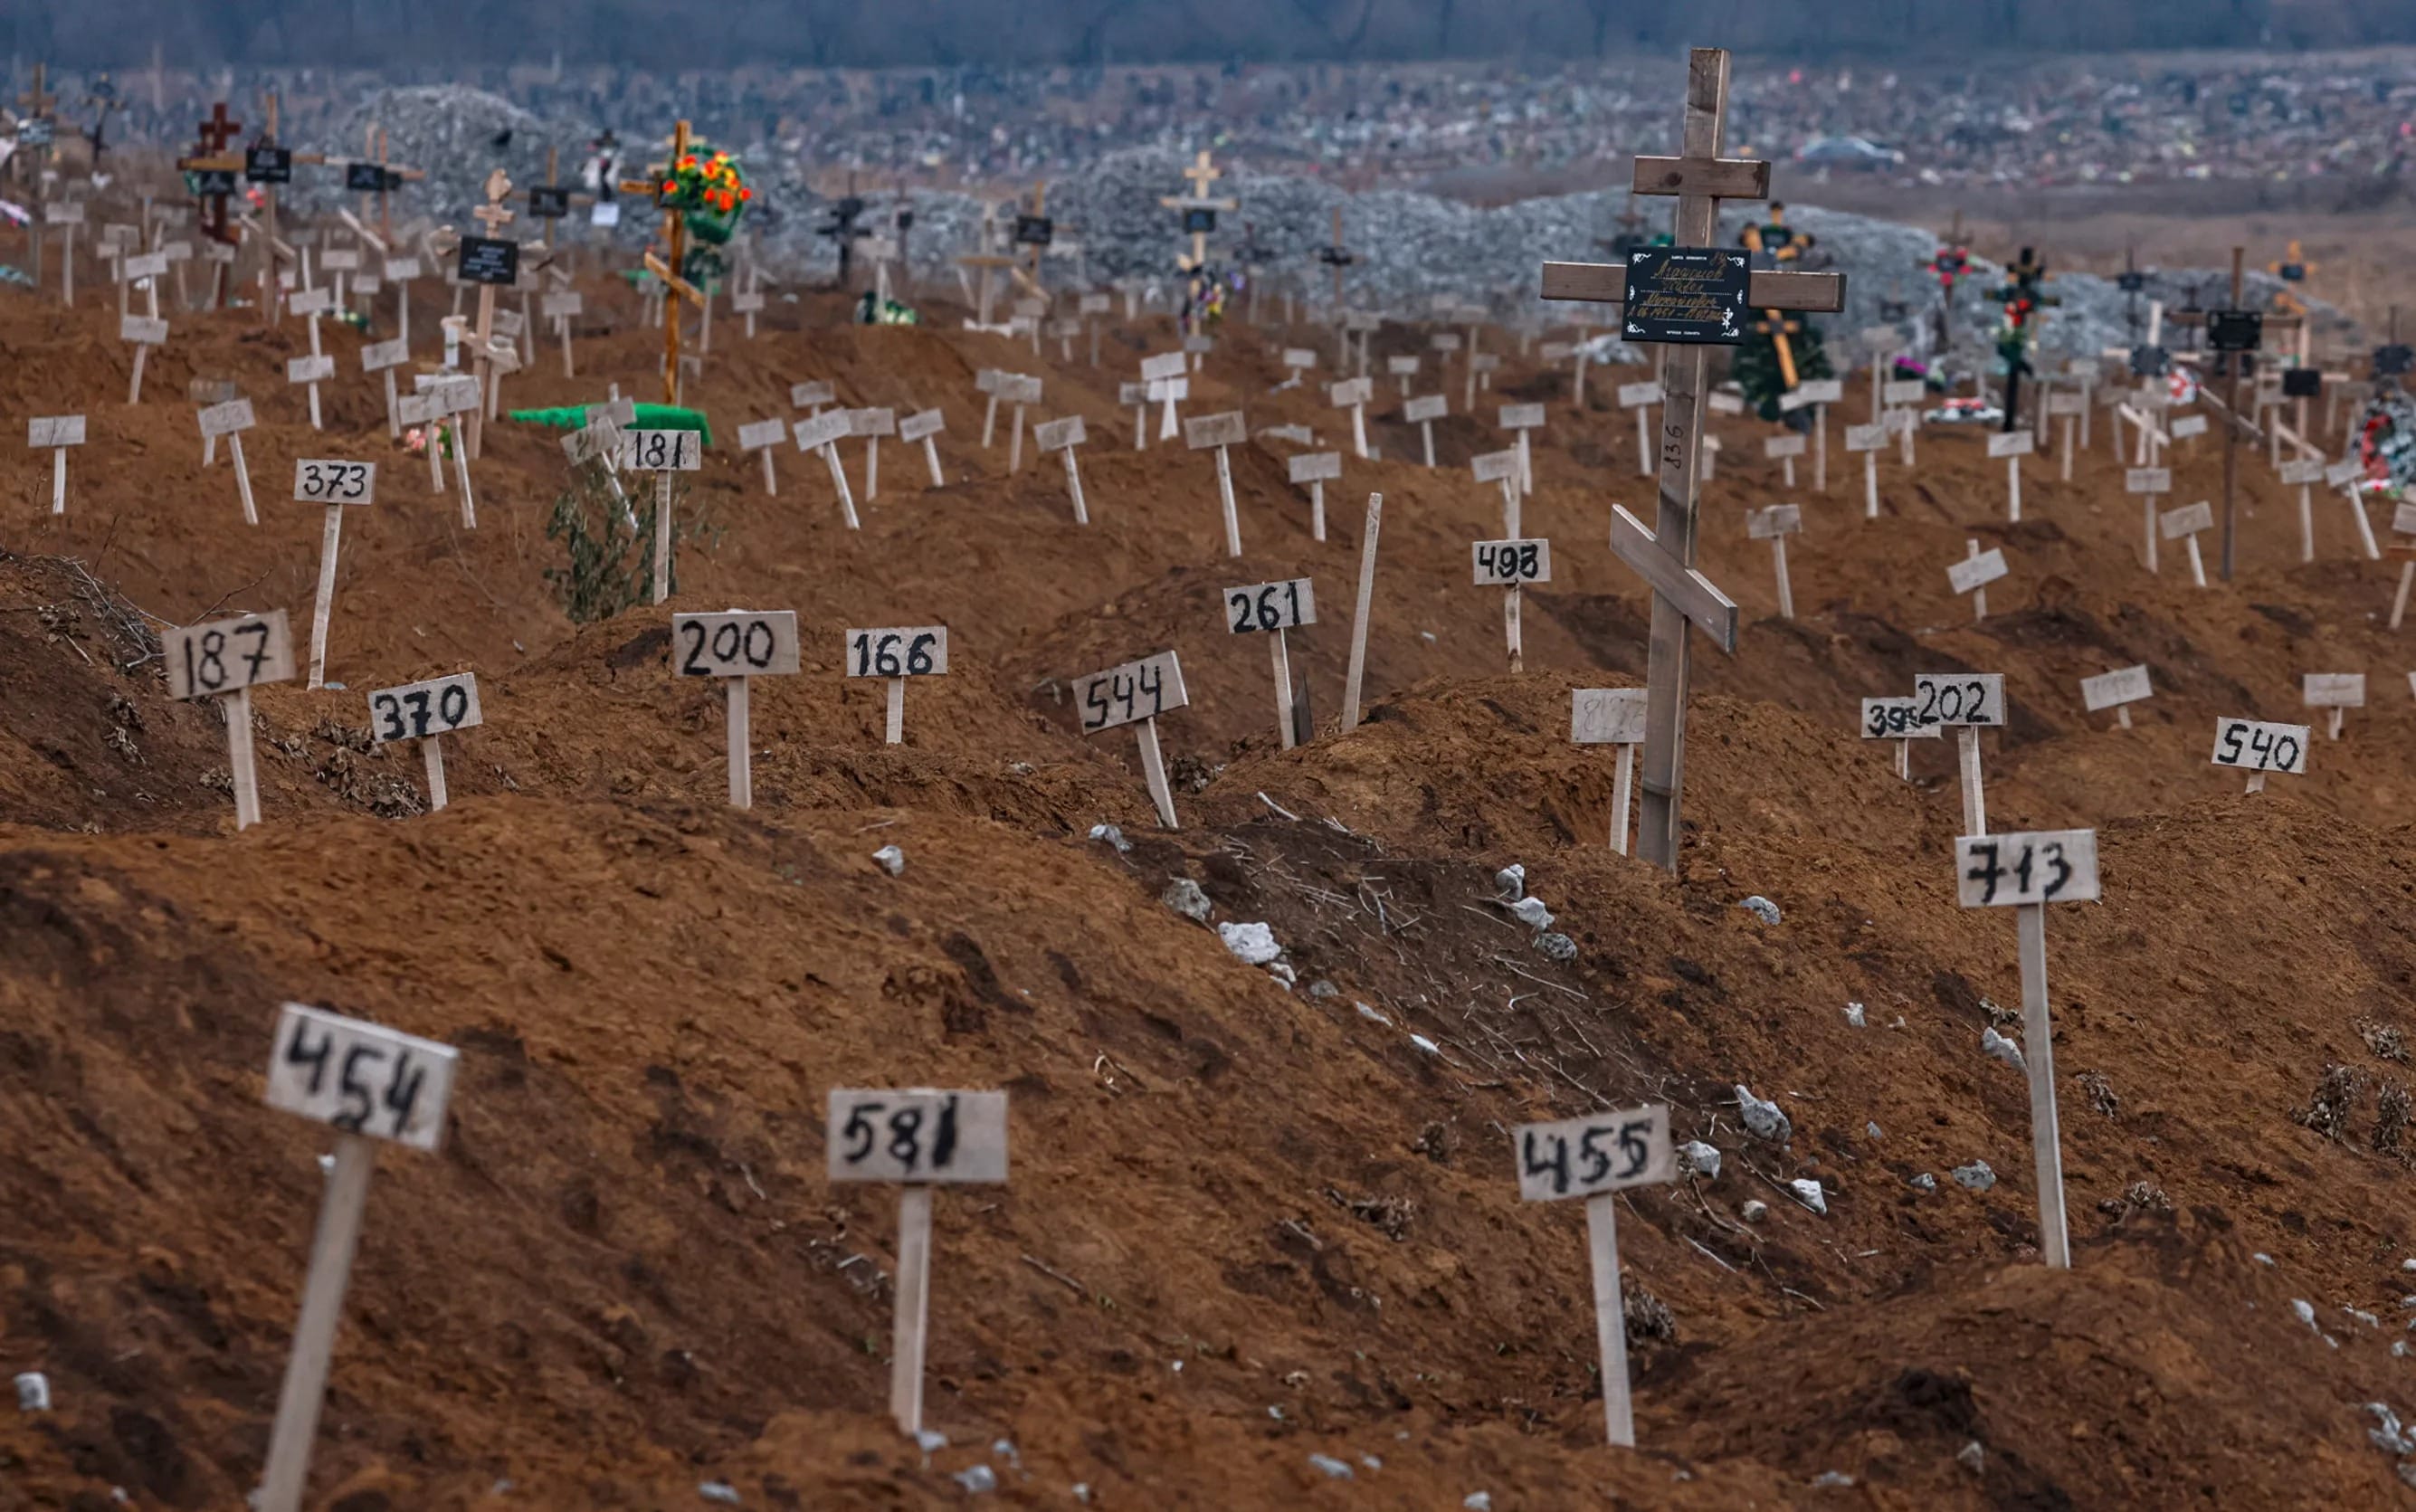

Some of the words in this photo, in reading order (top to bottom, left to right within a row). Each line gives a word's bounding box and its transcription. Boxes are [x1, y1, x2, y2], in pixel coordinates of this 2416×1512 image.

[634, 430, 685, 470] 181
[303, 464, 366, 499] 373
[1231, 582, 1301, 633] 261
[184, 622, 273, 695] 187
[680, 620, 775, 675] 200
[853, 632, 936, 677] 166
[375, 684, 469, 740] 370
[1085, 664, 1161, 727] 544
[1918, 680, 1992, 725] 202
[2217, 723, 2299, 772] 540
[1967, 842, 2072, 906] 713
[286, 1014, 426, 1138] 454
[843, 1093, 959, 1173] 581
[1523, 1118, 1653, 1194] 455
